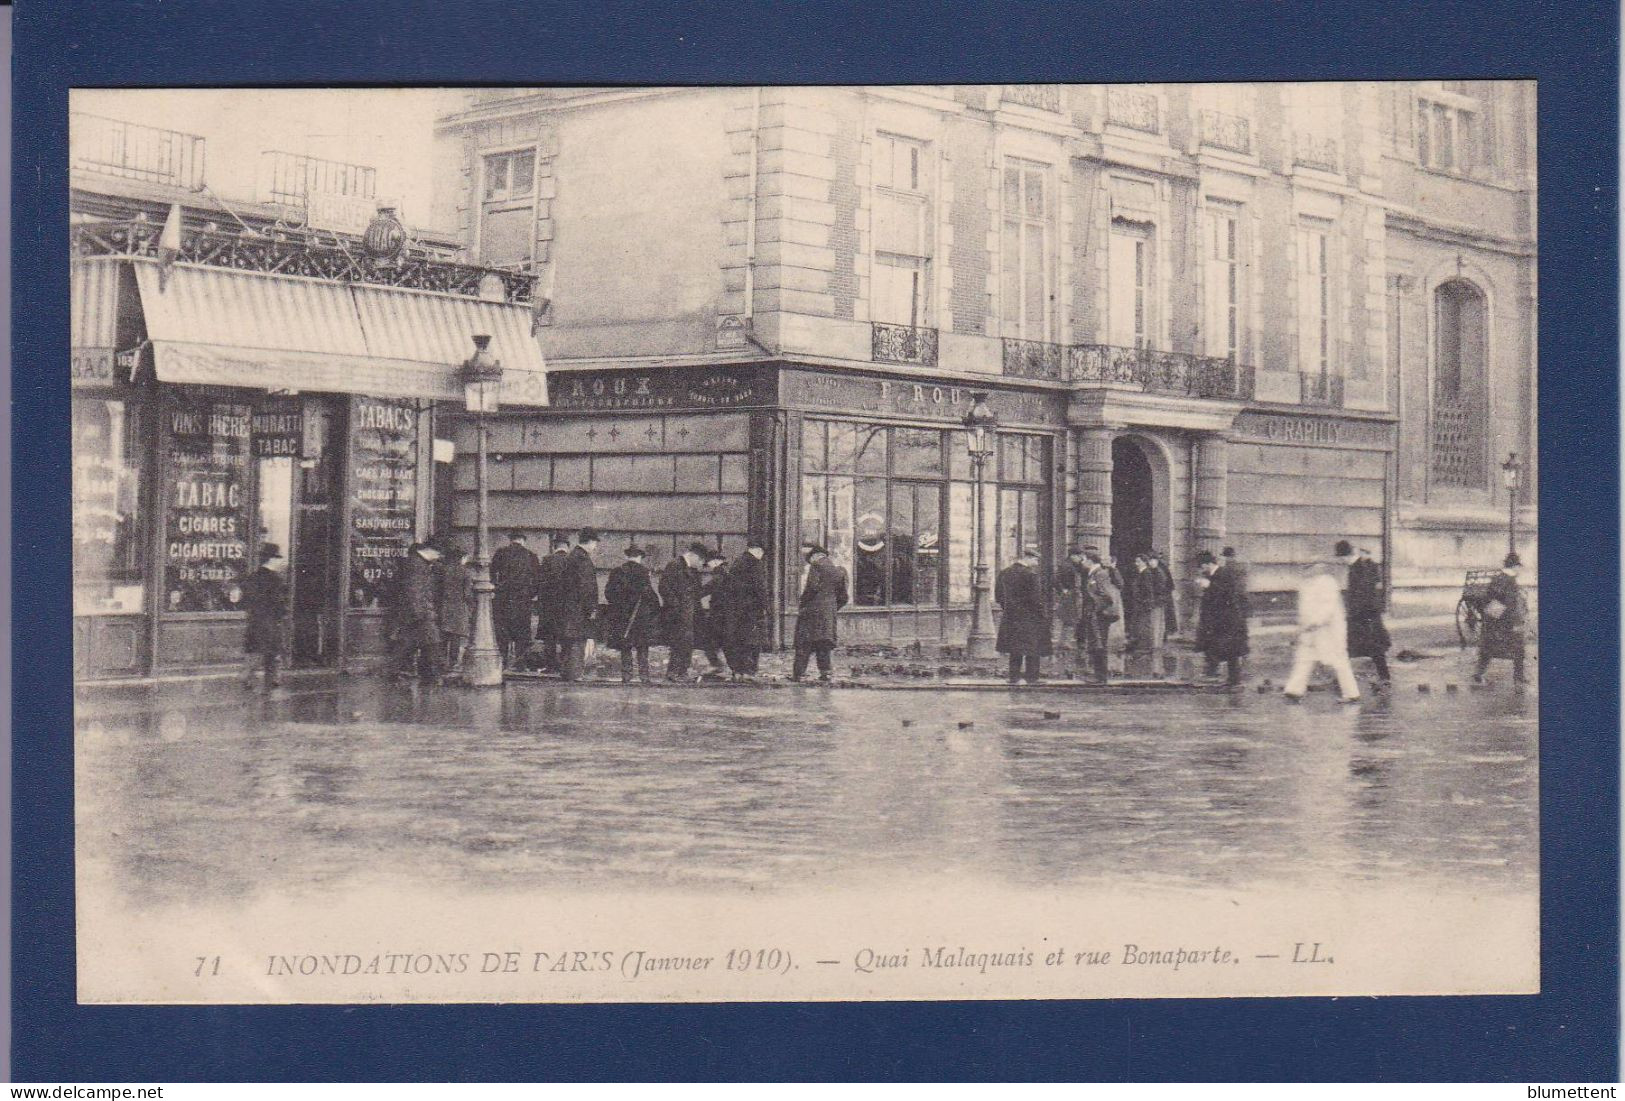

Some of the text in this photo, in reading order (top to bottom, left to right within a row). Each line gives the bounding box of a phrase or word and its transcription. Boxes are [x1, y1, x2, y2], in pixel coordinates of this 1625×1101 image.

[358, 405, 412, 430] TABACS
[258, 438, 297, 454] TABAC
[176, 481, 240, 508] TABAC
[178, 516, 236, 533] CIGARES
[170, 543, 244, 559] CIGARETTES
[194, 955, 221, 977] 71
[266, 952, 470, 976] INONDATIONS
[480, 952, 521, 974] DE
[620, 950, 715, 979] (Janvier
[725, 948, 800, 977] 1910).
[854, 948, 910, 973] Quai
[920, 946, 1034, 974] Malaquais
[1044, 948, 1065, 966] et
[1074, 950, 1112, 966] rue
[1121, 944, 1241, 971] Bonaparte.
[1291, 942, 1335, 964] LL.
